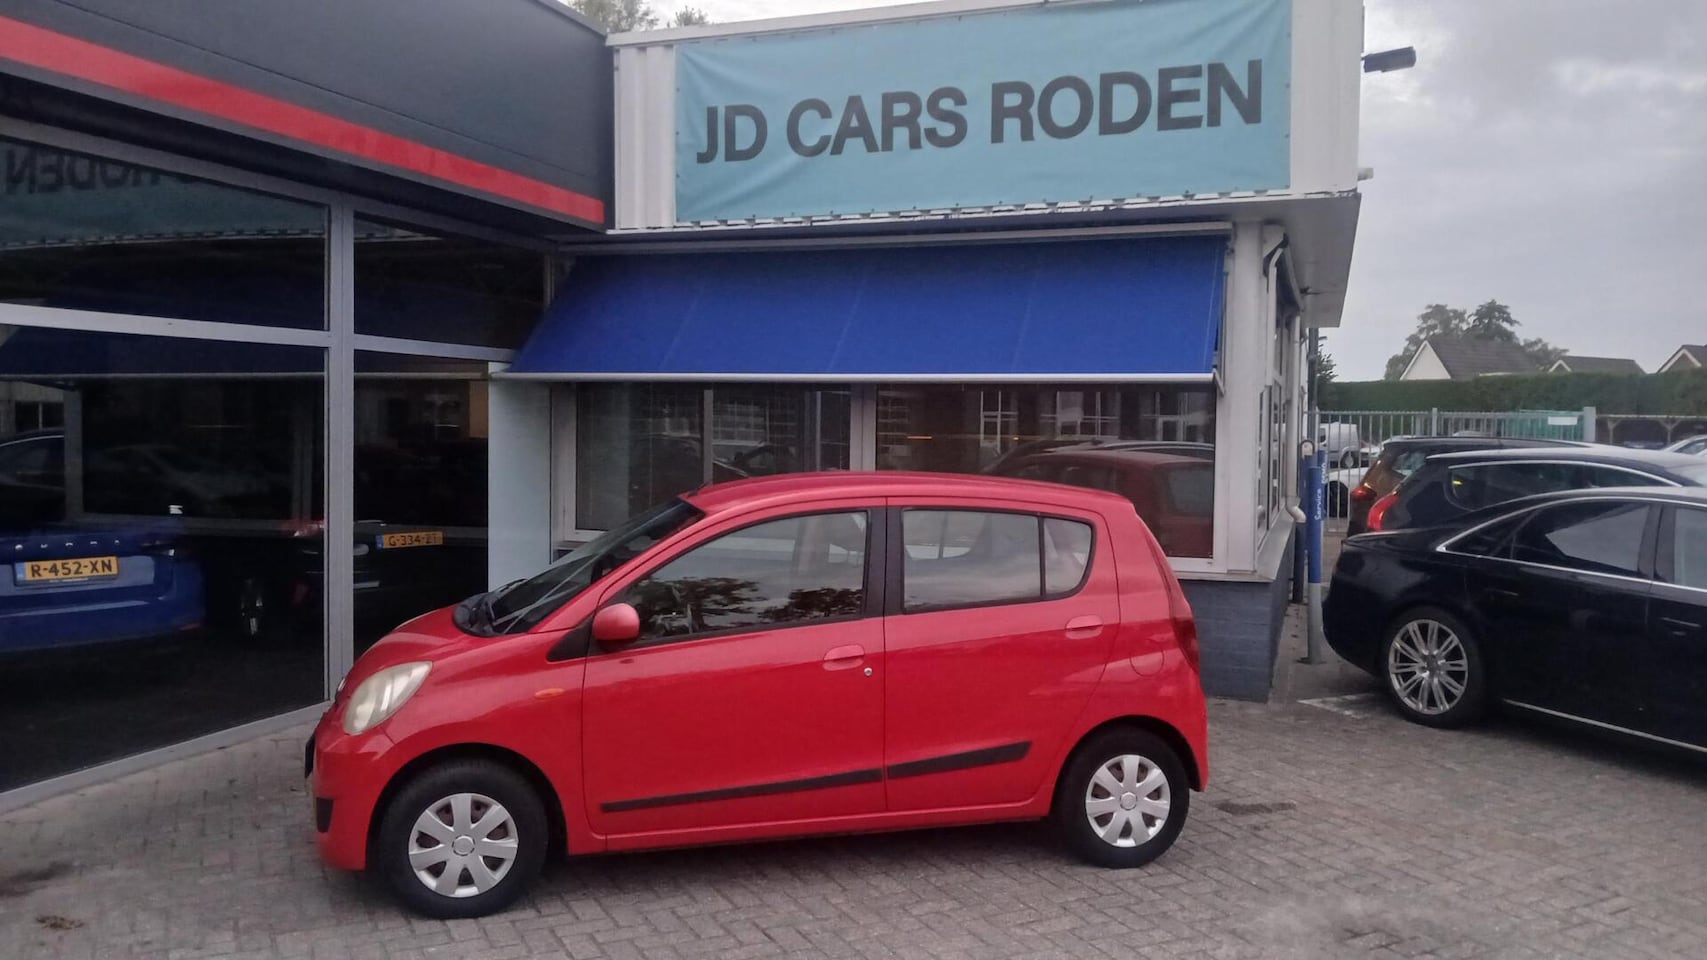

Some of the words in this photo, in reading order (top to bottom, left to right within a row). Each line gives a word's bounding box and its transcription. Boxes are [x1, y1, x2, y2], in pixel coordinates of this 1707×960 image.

[697, 104, 768, 164] JD
[786, 86, 968, 157] CARS
[990, 59, 1263, 144] RODEN
[1314, 488, 1322, 521] Service
[31, 559, 113, 577] R-452-XN
